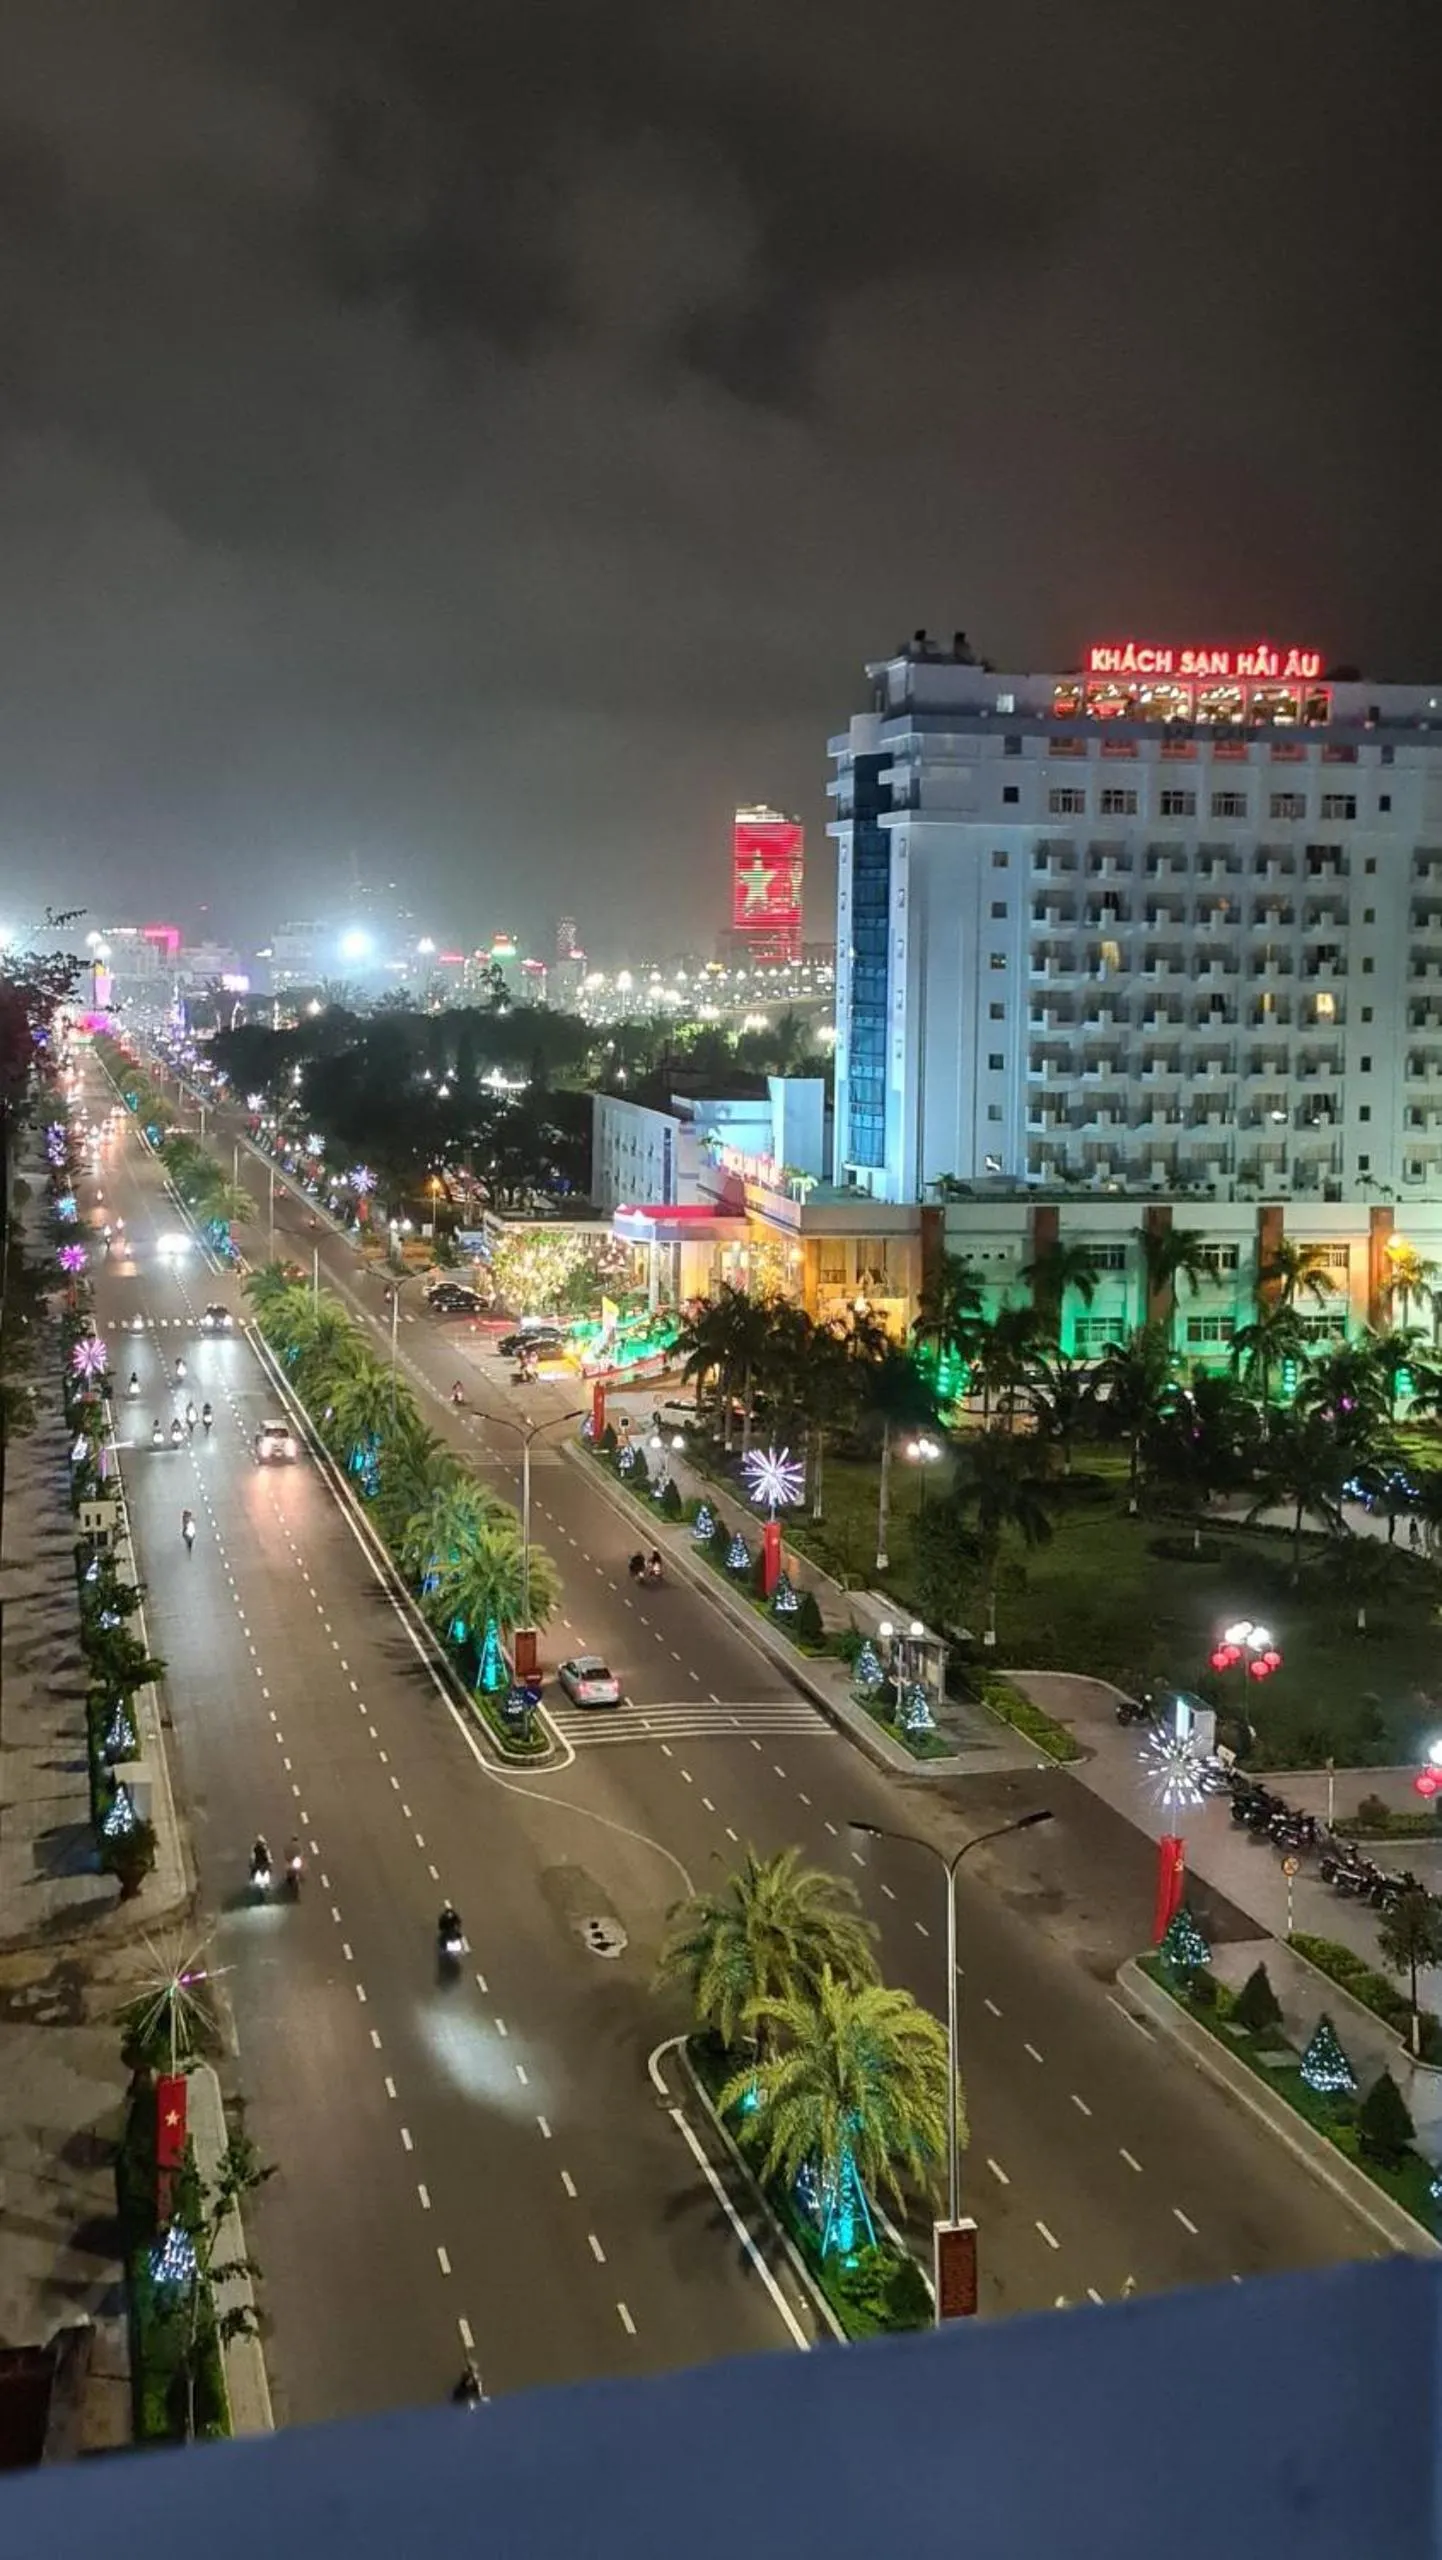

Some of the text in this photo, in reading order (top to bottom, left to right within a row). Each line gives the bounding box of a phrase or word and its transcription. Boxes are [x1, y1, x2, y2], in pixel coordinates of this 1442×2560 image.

[1091, 643, 1320, 677] KHÁCH SẠN HẢI ÂU
